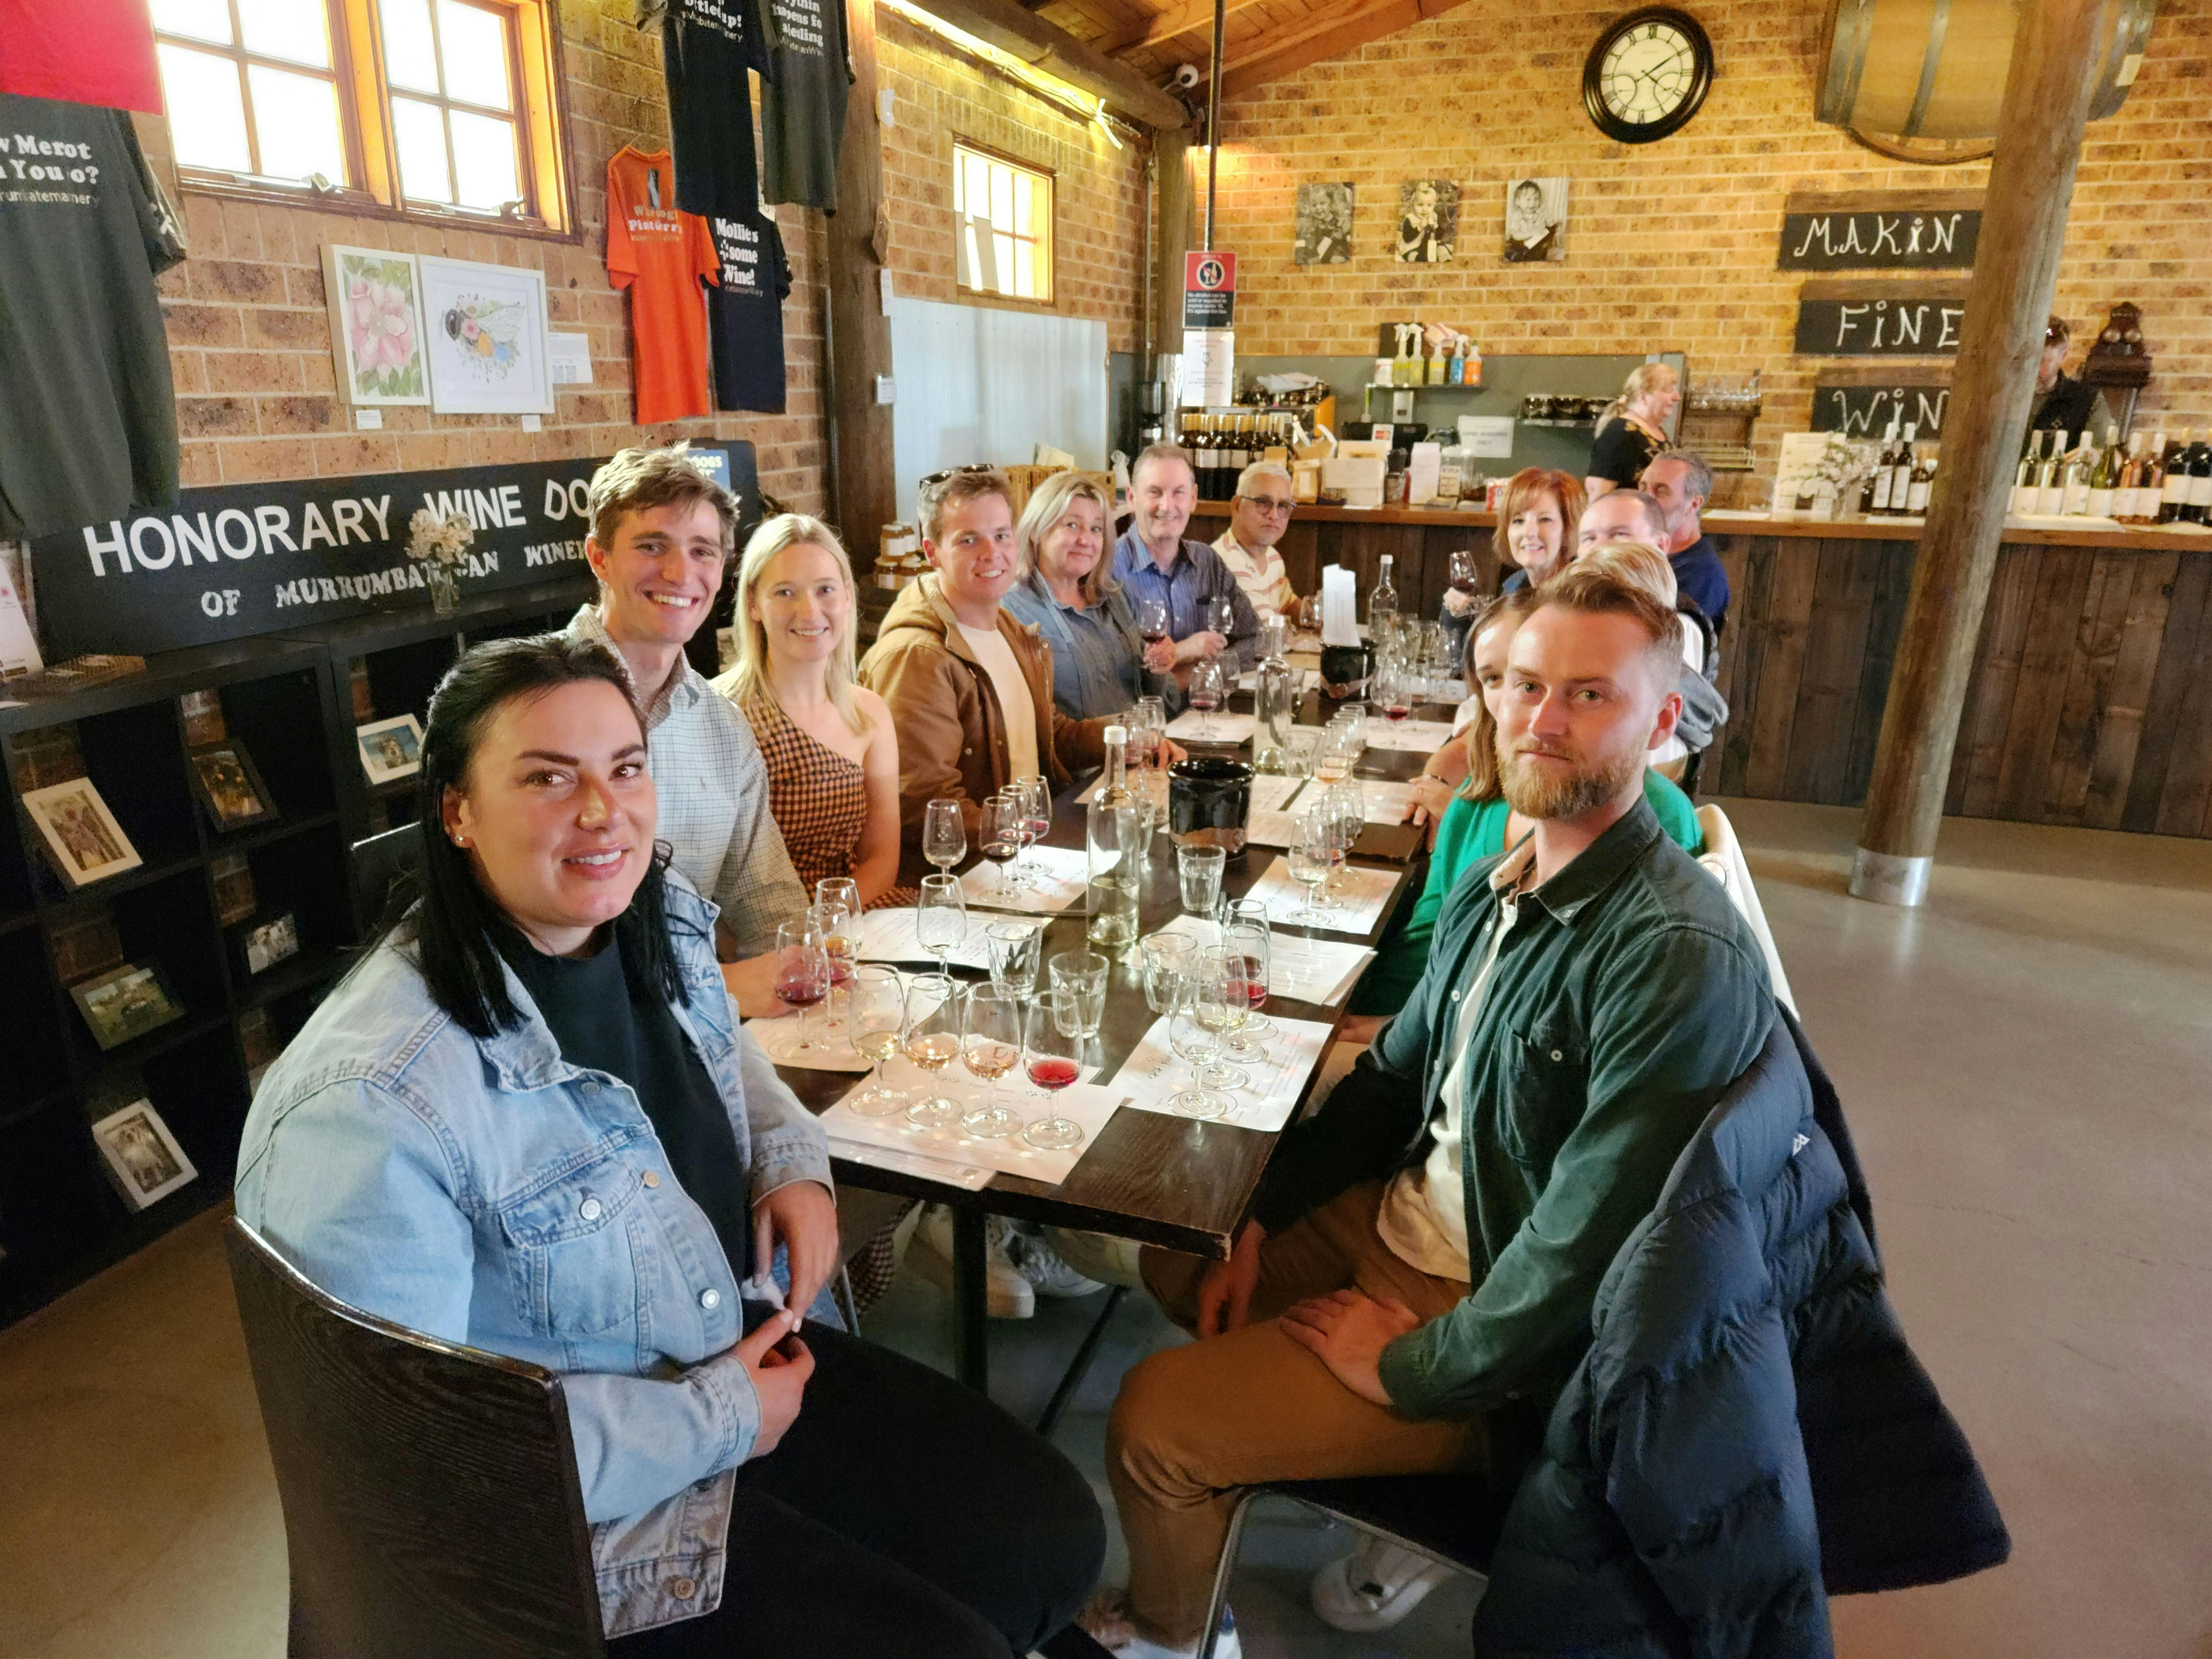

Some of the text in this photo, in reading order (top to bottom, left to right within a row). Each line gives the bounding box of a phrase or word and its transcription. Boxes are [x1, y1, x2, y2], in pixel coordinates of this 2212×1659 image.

[10, 159, 64, 180] You
[729, 246, 758, 264] some
[723, 263, 756, 286] Wine!
[1832, 388, 1950, 432] WiN
[83, 478, 590, 577] HONORARY WINE DO
[201, 540, 588, 617] OF MURRUMBATAN WINER
